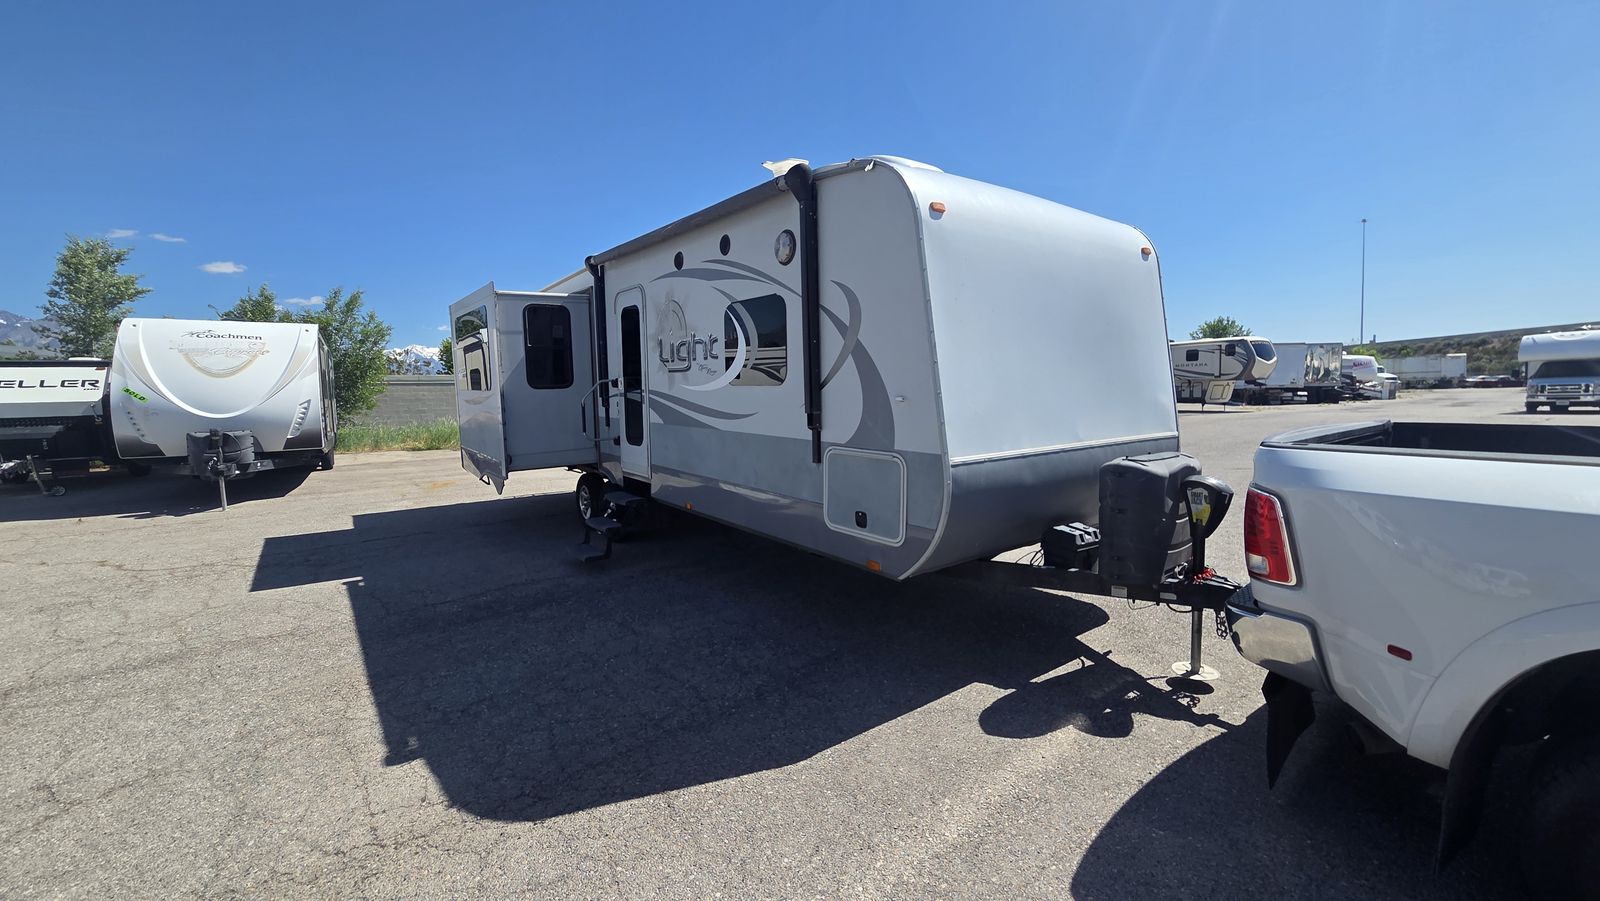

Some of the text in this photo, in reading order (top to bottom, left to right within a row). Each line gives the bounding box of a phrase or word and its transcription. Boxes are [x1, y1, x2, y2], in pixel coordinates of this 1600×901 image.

[657, 330, 719, 373] Light
[0, 379, 100, 389] ELLER
[123, 388, 146, 401] SOLD
